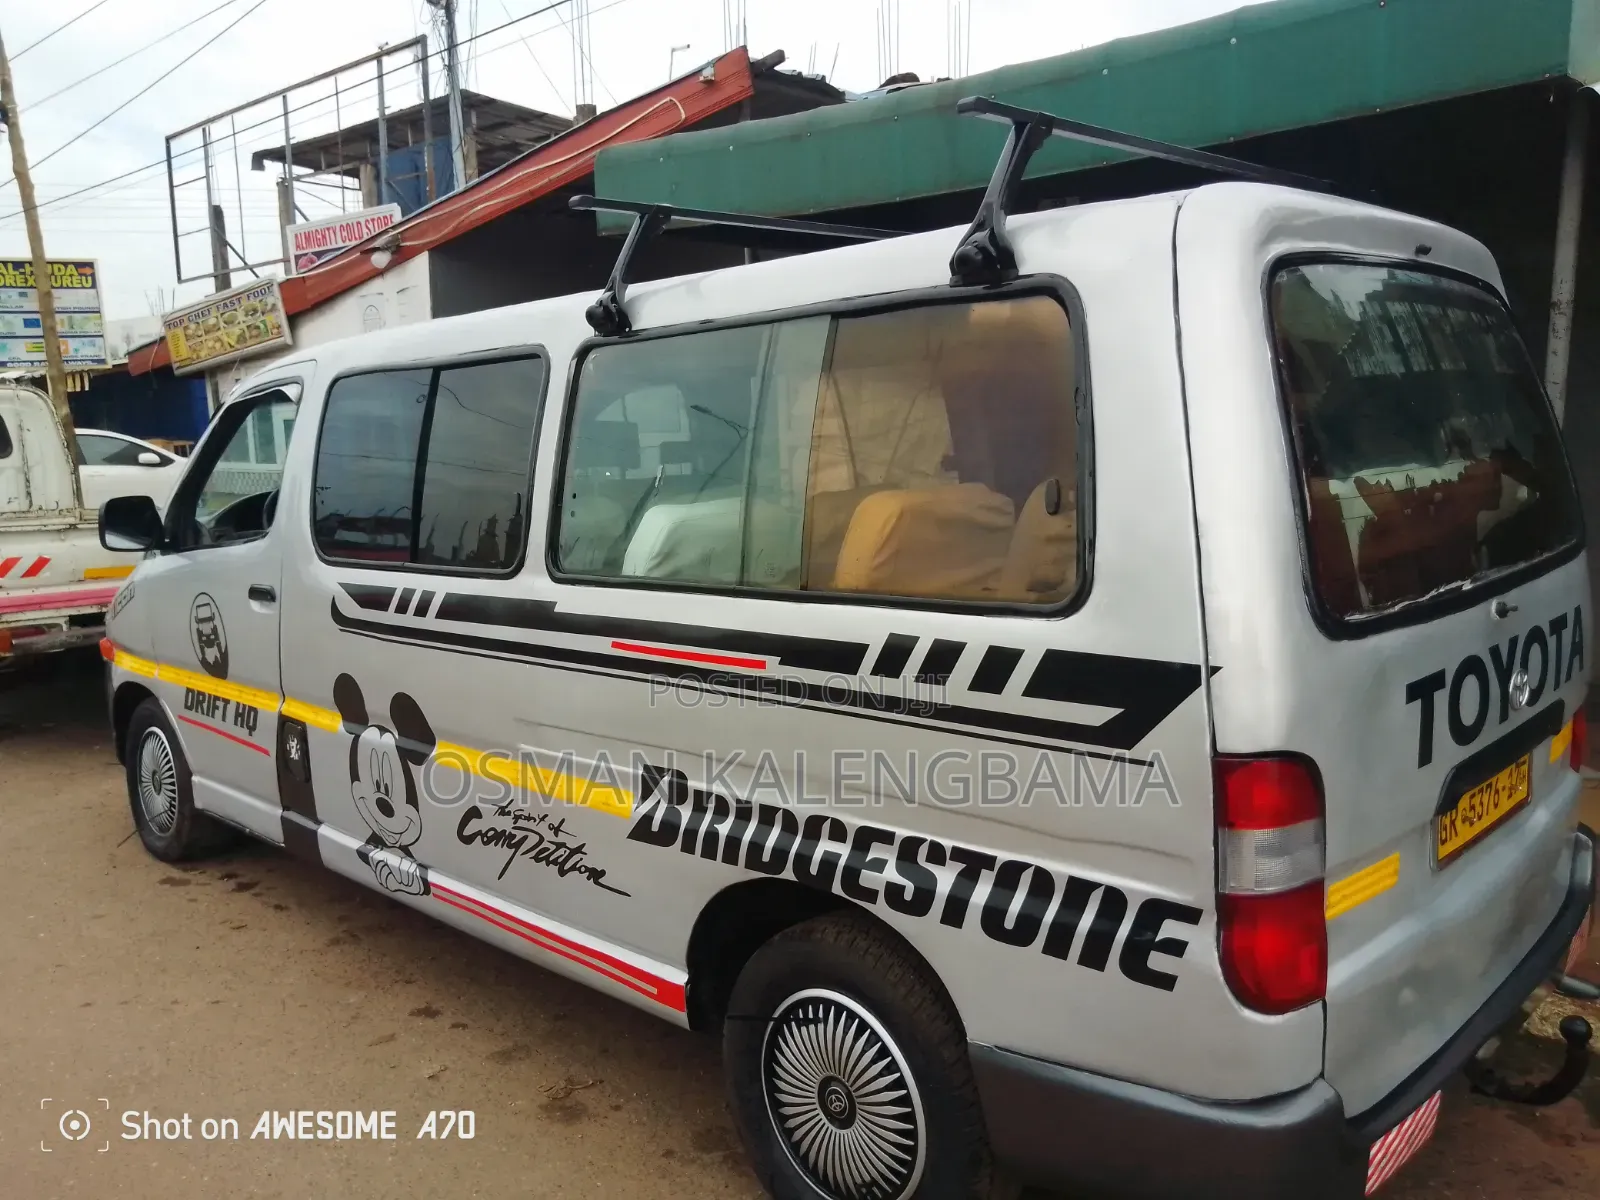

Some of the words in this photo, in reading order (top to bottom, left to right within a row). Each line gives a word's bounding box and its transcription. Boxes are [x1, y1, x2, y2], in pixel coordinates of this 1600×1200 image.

[294, 226, 338, 252] ALMIGHTY
[339, 220, 365, 244] COLD
[165, 318, 185, 330] TOP
[187, 307, 215, 323] CHEF
[216, 296, 243, 312] FAST
[1405, 604, 1584, 769] TOYOTA
[184, 687, 230, 722] DRIFT
[234, 700, 259, 736] HQ
[491, 799, 514, 816] The
[548, 818, 577, 837] of
[1440, 809, 1458, 846] GR
[626, 764, 1203, 992] BRIDGESTONE
